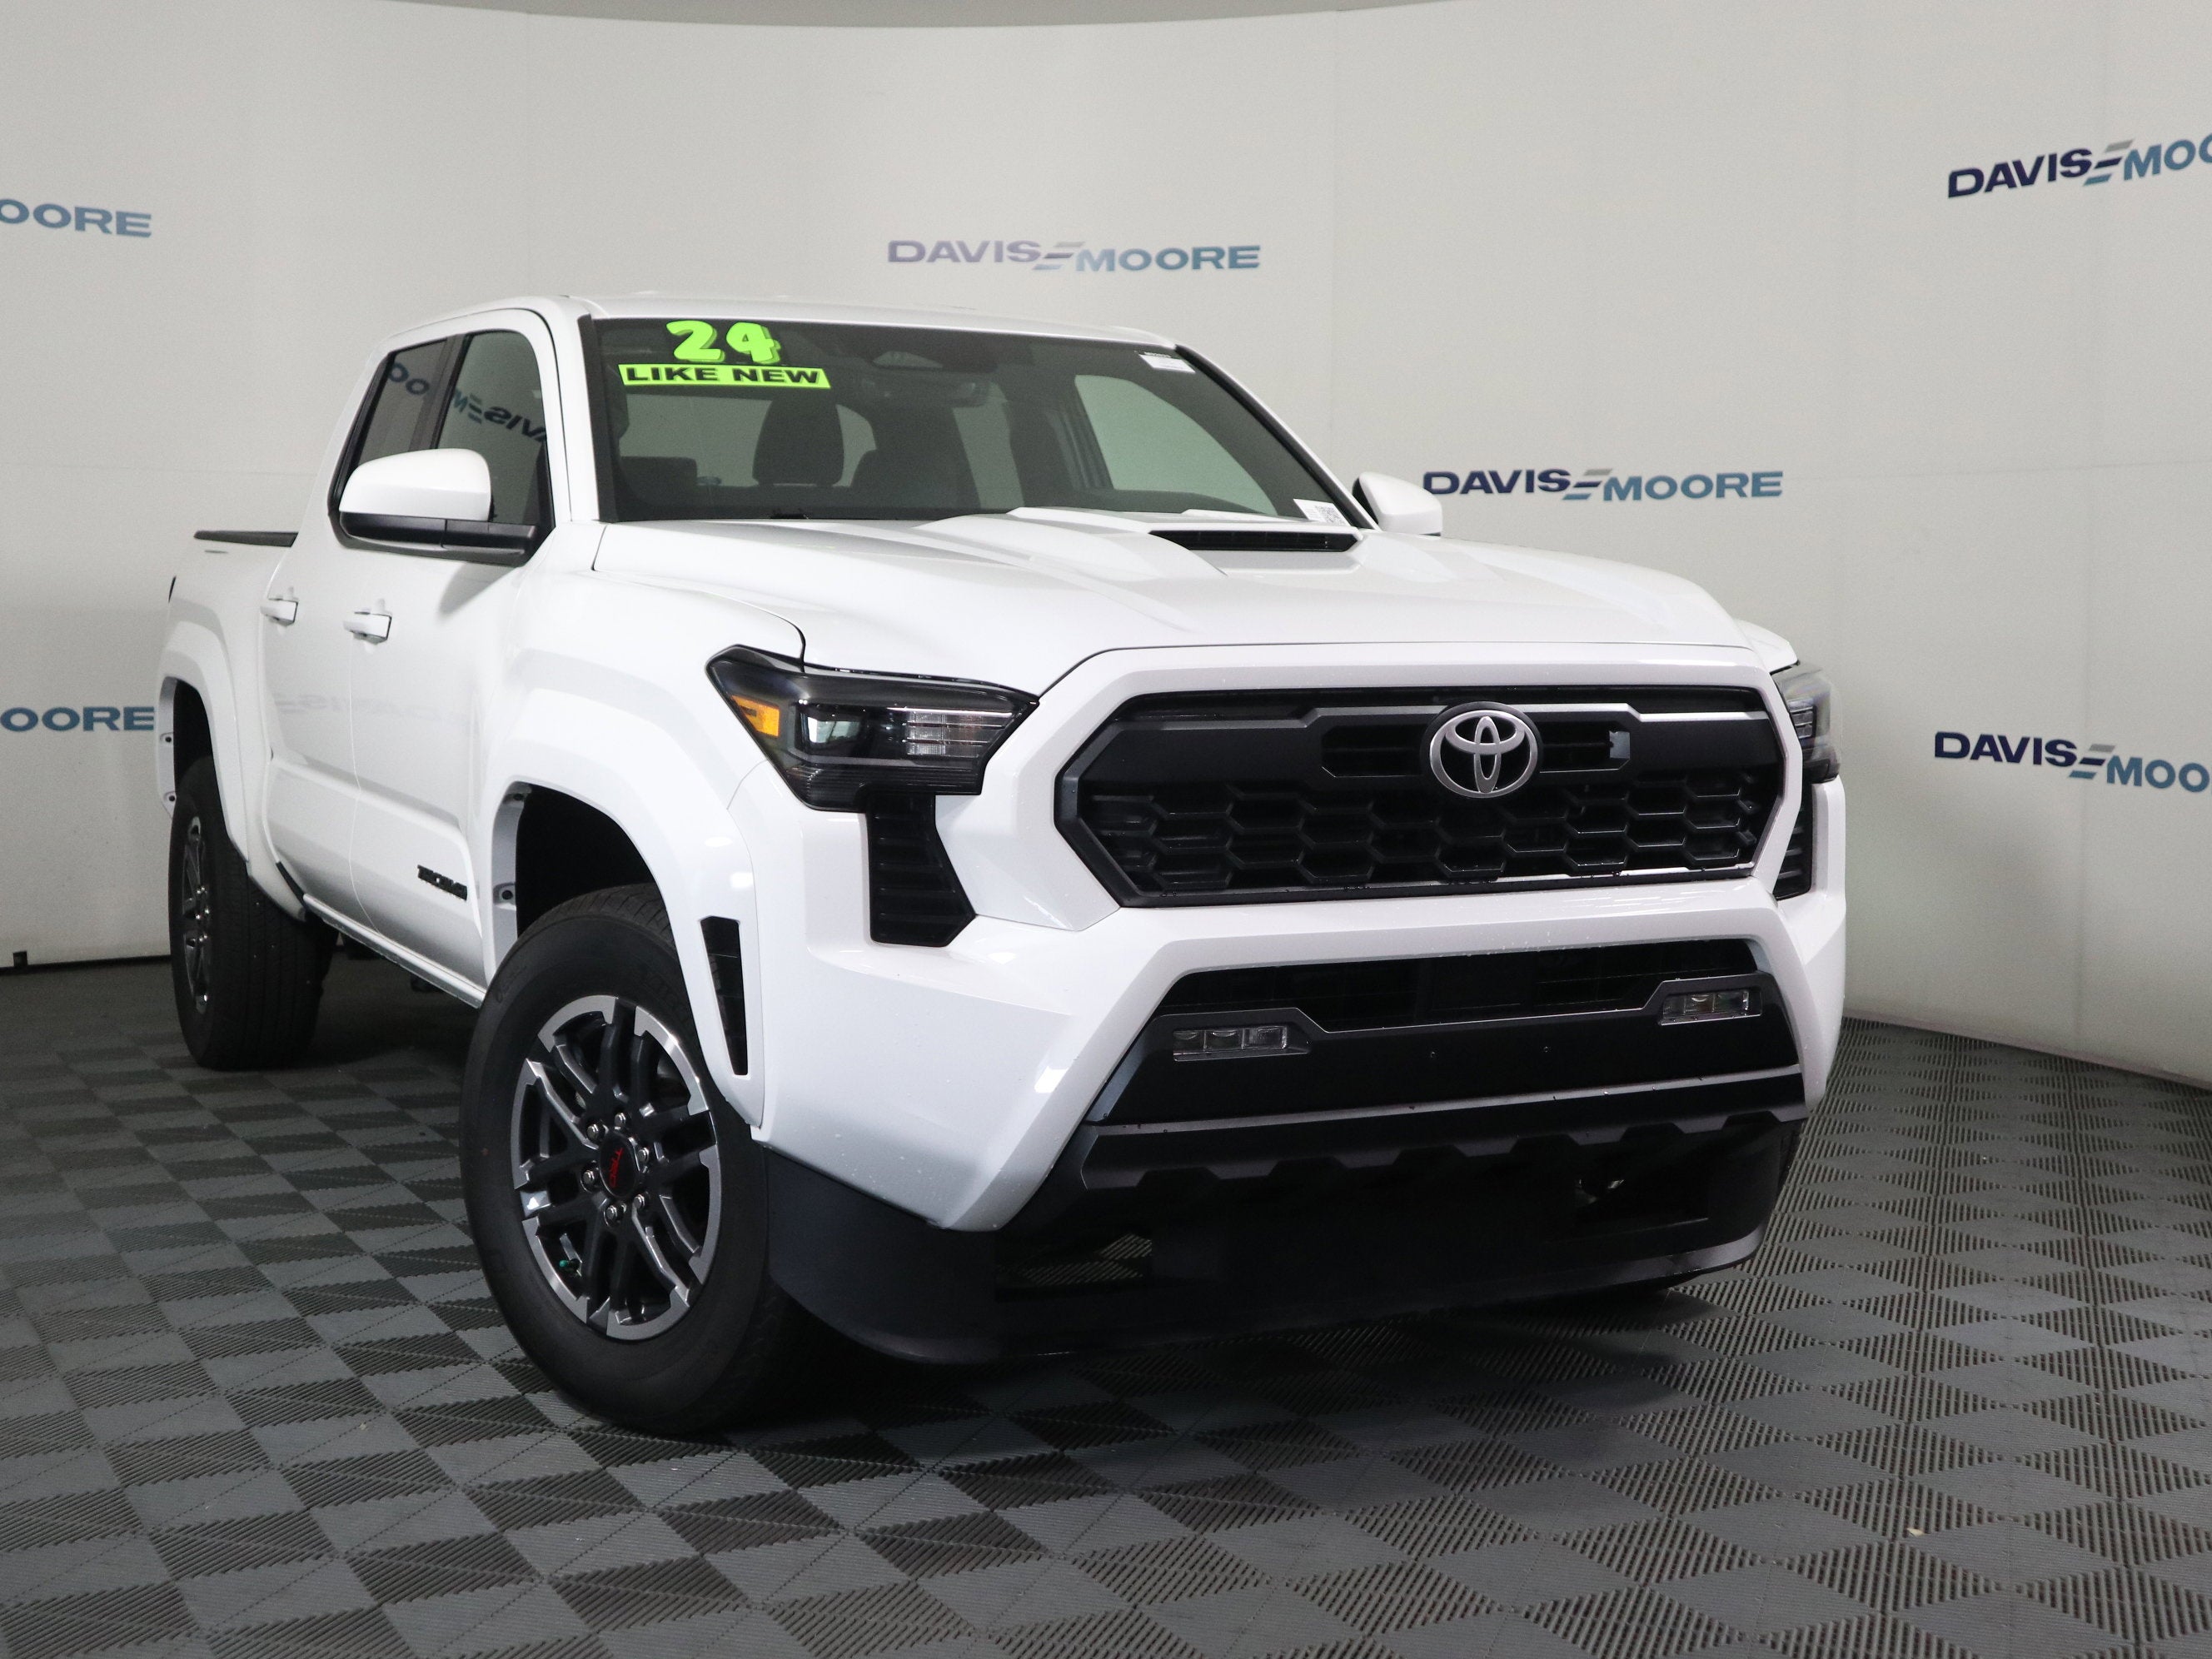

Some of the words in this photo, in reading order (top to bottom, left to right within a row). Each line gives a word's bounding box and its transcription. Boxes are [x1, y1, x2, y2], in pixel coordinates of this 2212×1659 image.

[1948, 148, 2093, 198] DAVIS
[887, 239, 1041, 262] DAVIS
[1074, 245, 1262, 272] MOORE
[666, 320, 781, 364] 24
[626, 366, 719, 382] LIKE
[731, 367, 820, 383] NEW
[1423, 468, 1571, 495] DAVIS
[1602, 471, 1783, 501] MOORE
[1935, 731, 2077, 767] DAVIS
